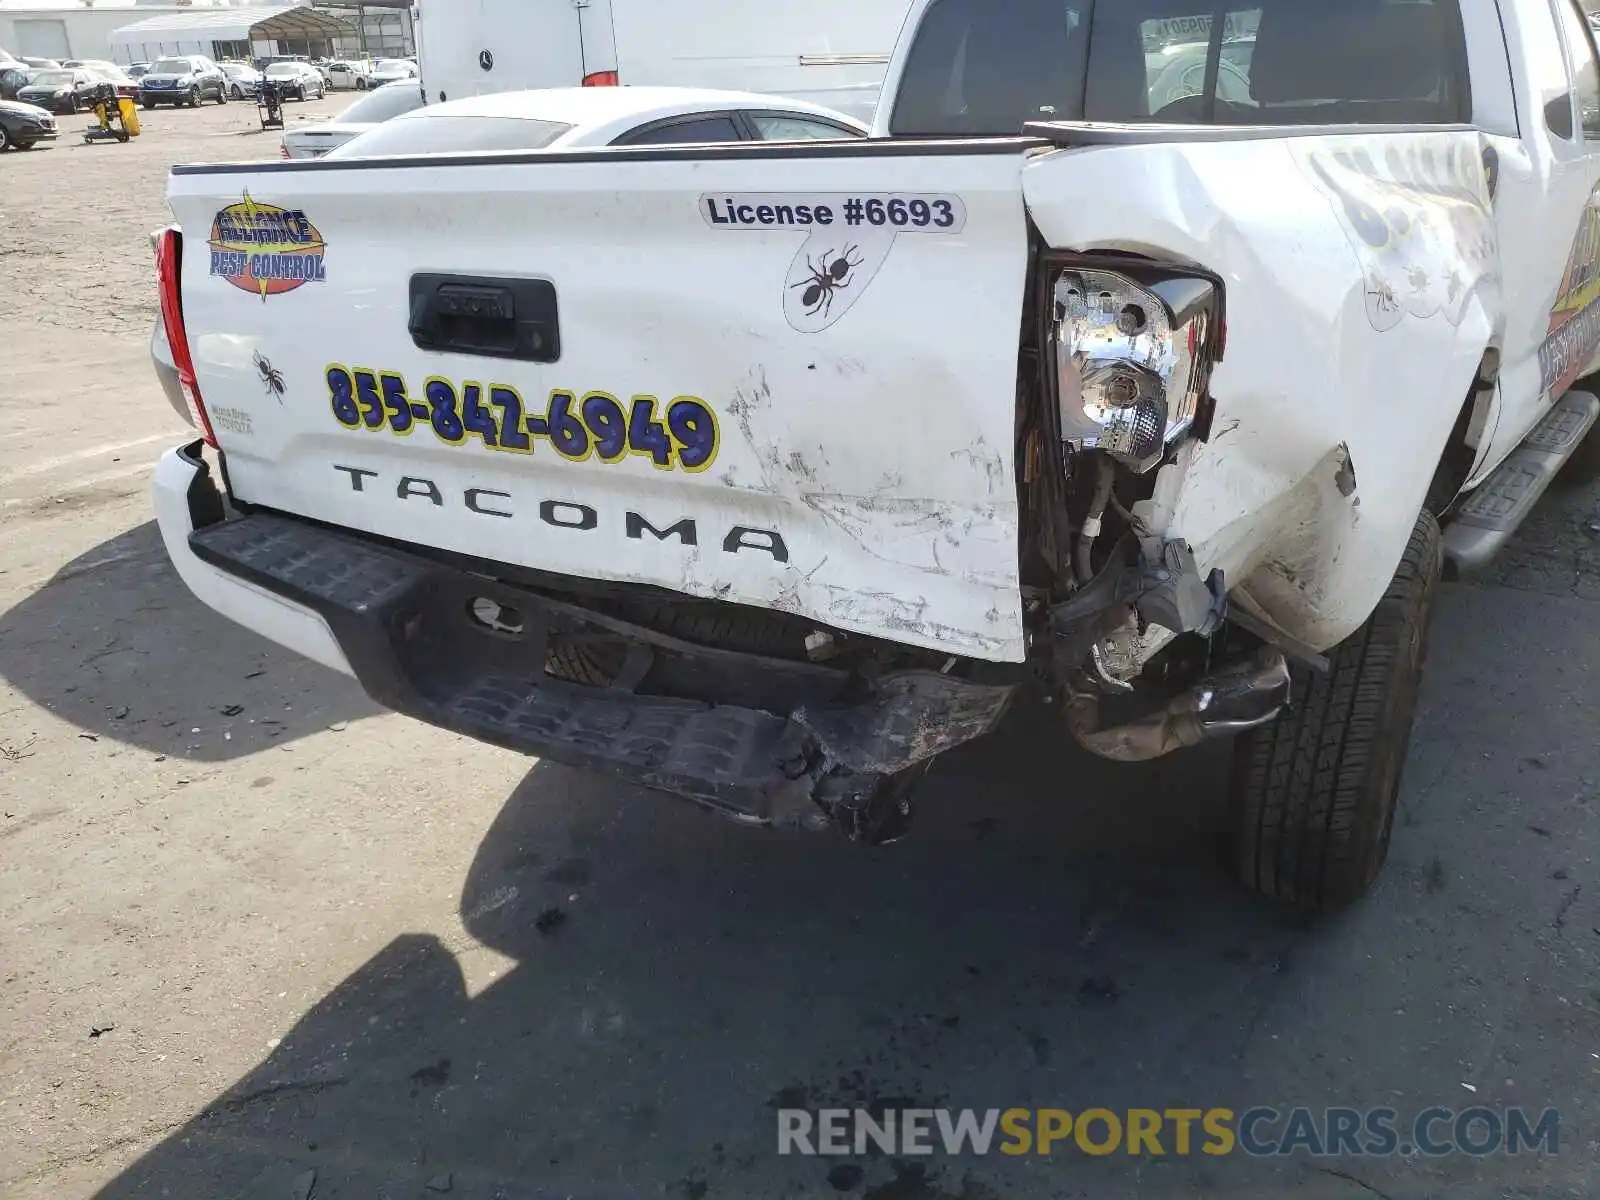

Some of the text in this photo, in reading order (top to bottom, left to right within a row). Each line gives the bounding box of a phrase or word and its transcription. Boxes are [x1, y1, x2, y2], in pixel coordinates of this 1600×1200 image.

[216, 209, 313, 244] ALLIANCE
[707, 198, 955, 227] License #6693
[210, 251, 326, 281] PEST CONTROL
[326, 363, 719, 471] 855-842-6949
[333, 464, 789, 563] TACOMA
